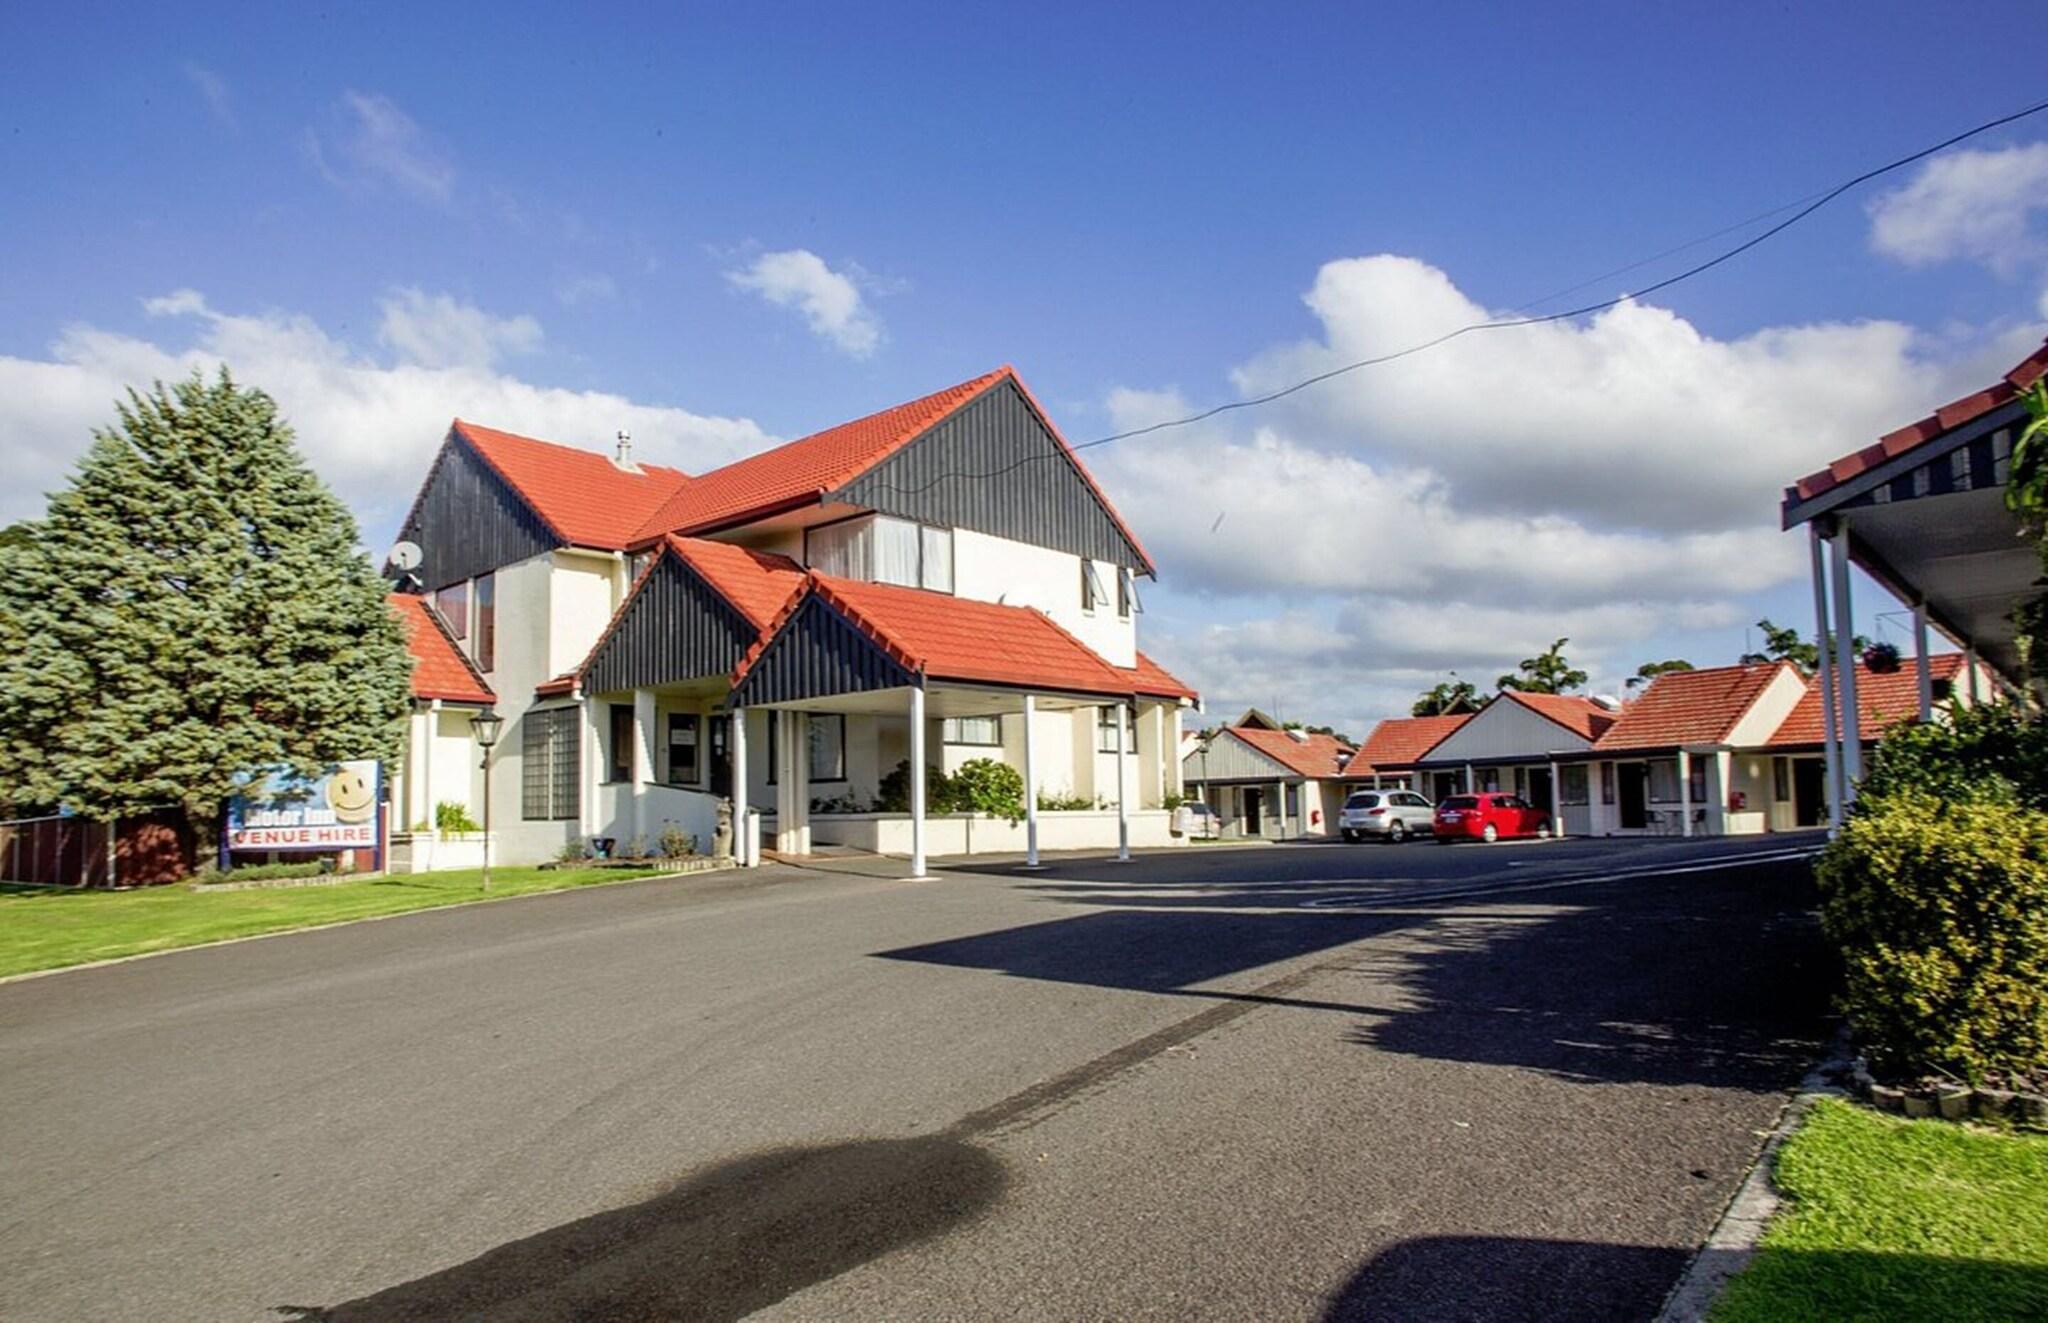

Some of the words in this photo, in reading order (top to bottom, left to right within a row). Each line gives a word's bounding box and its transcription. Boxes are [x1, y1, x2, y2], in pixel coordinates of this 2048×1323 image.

[303, 807, 335, 825] Inn
[235, 829, 310, 844] VENUE
[318, 827, 370, 842] HIRE
